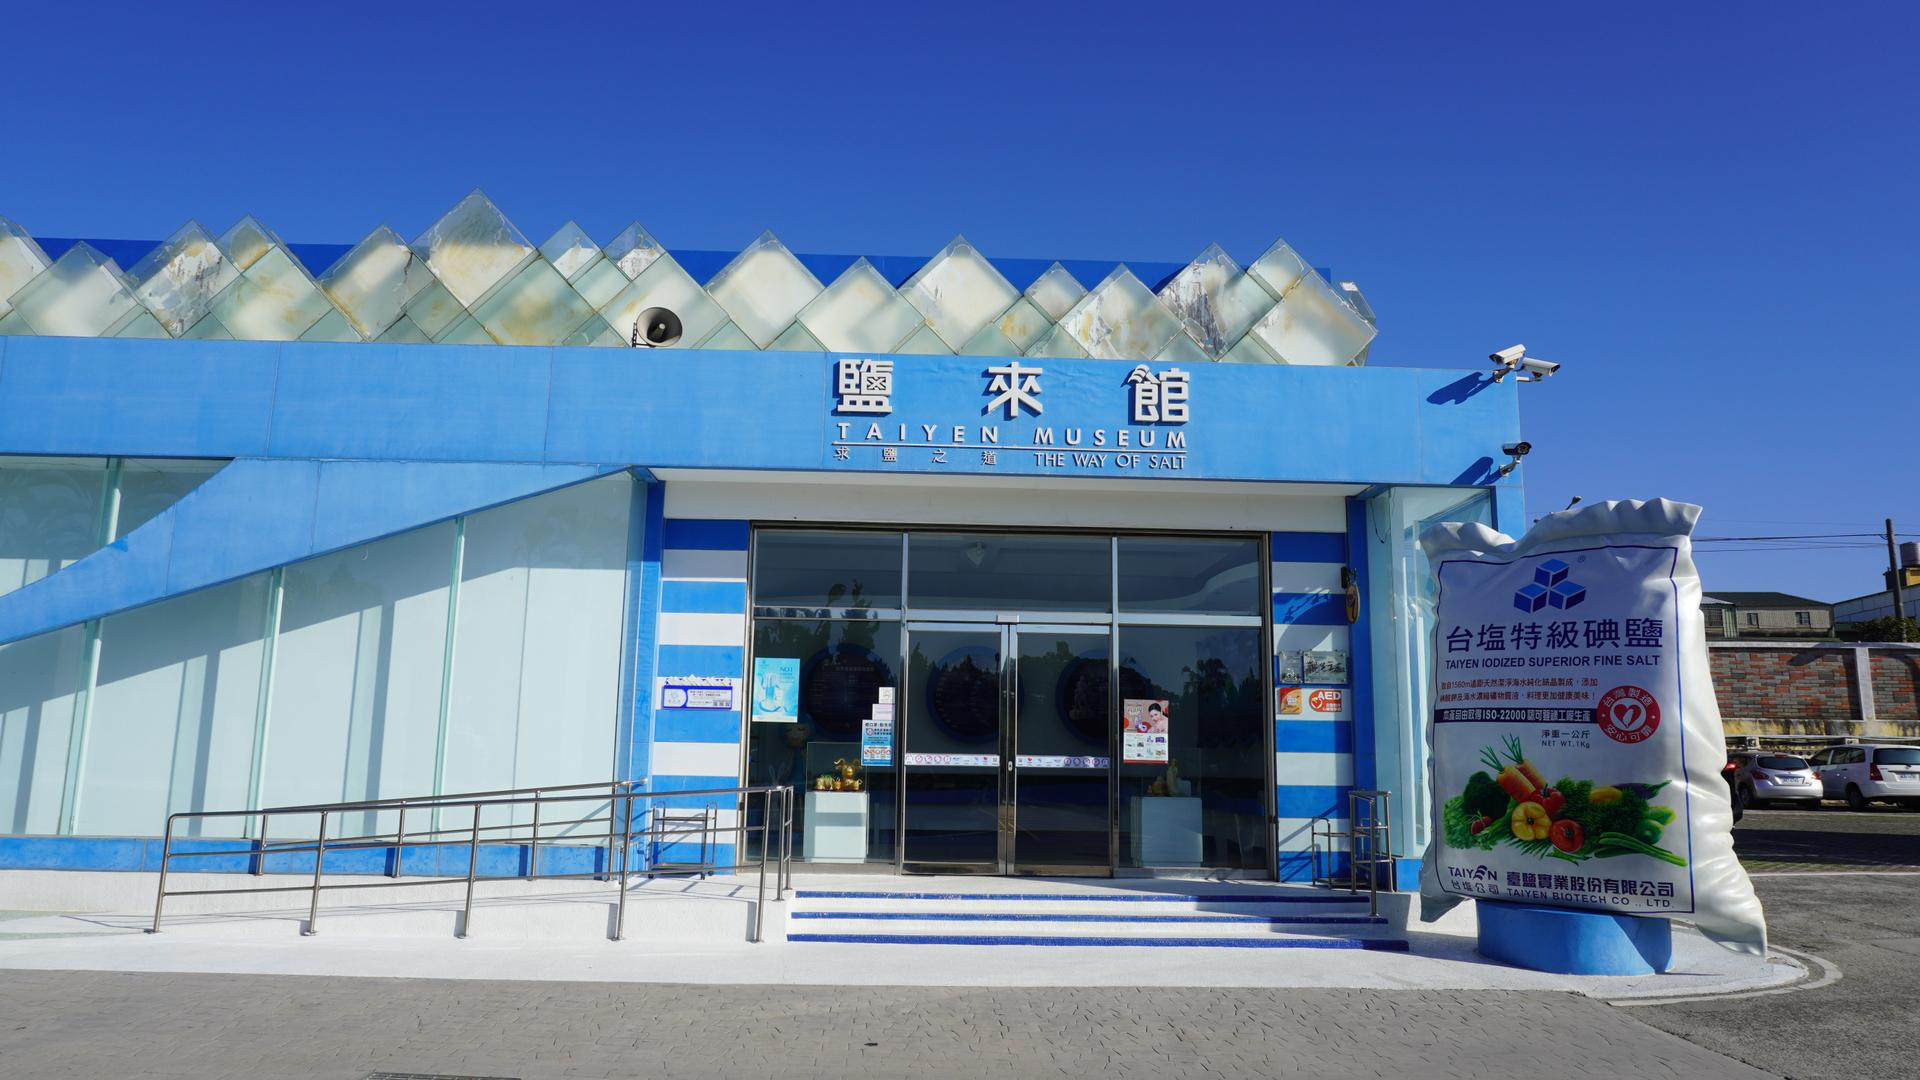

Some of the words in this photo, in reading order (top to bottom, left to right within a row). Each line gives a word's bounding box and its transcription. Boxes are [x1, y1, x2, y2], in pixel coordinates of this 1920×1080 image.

[837, 358, 1190, 422] 鹽來館
[836, 422, 998, 443] TAIYEN
[1034, 427, 1187, 448] MUSEUM
[1034, 452, 1065, 467] THE
[1072, 453, 1108, 468] WAY
[1115, 454, 1141, 469] OF
[1149, 455, 1187, 470] SALT
[1446, 617, 1663, 653] 台塩特級碘鹽
[1445, 658, 1479, 670] TAIYEN
[1481, 657, 1526, 668] IODIZED
[1528, 656, 1590, 668] SUPERIOR
[1593, 655, 1622, 667] FINE
[1626, 655, 1660, 666] SALT
[1317, 691, 1341, 700] AED
[1541, 729, 1590, 739] 淨重一公斤
[1451, 880, 1499, 895] 台塩公司
[1507, 888, 1547, 900] TAIYEN
[1552, 892, 1607, 904] BIOTECH
